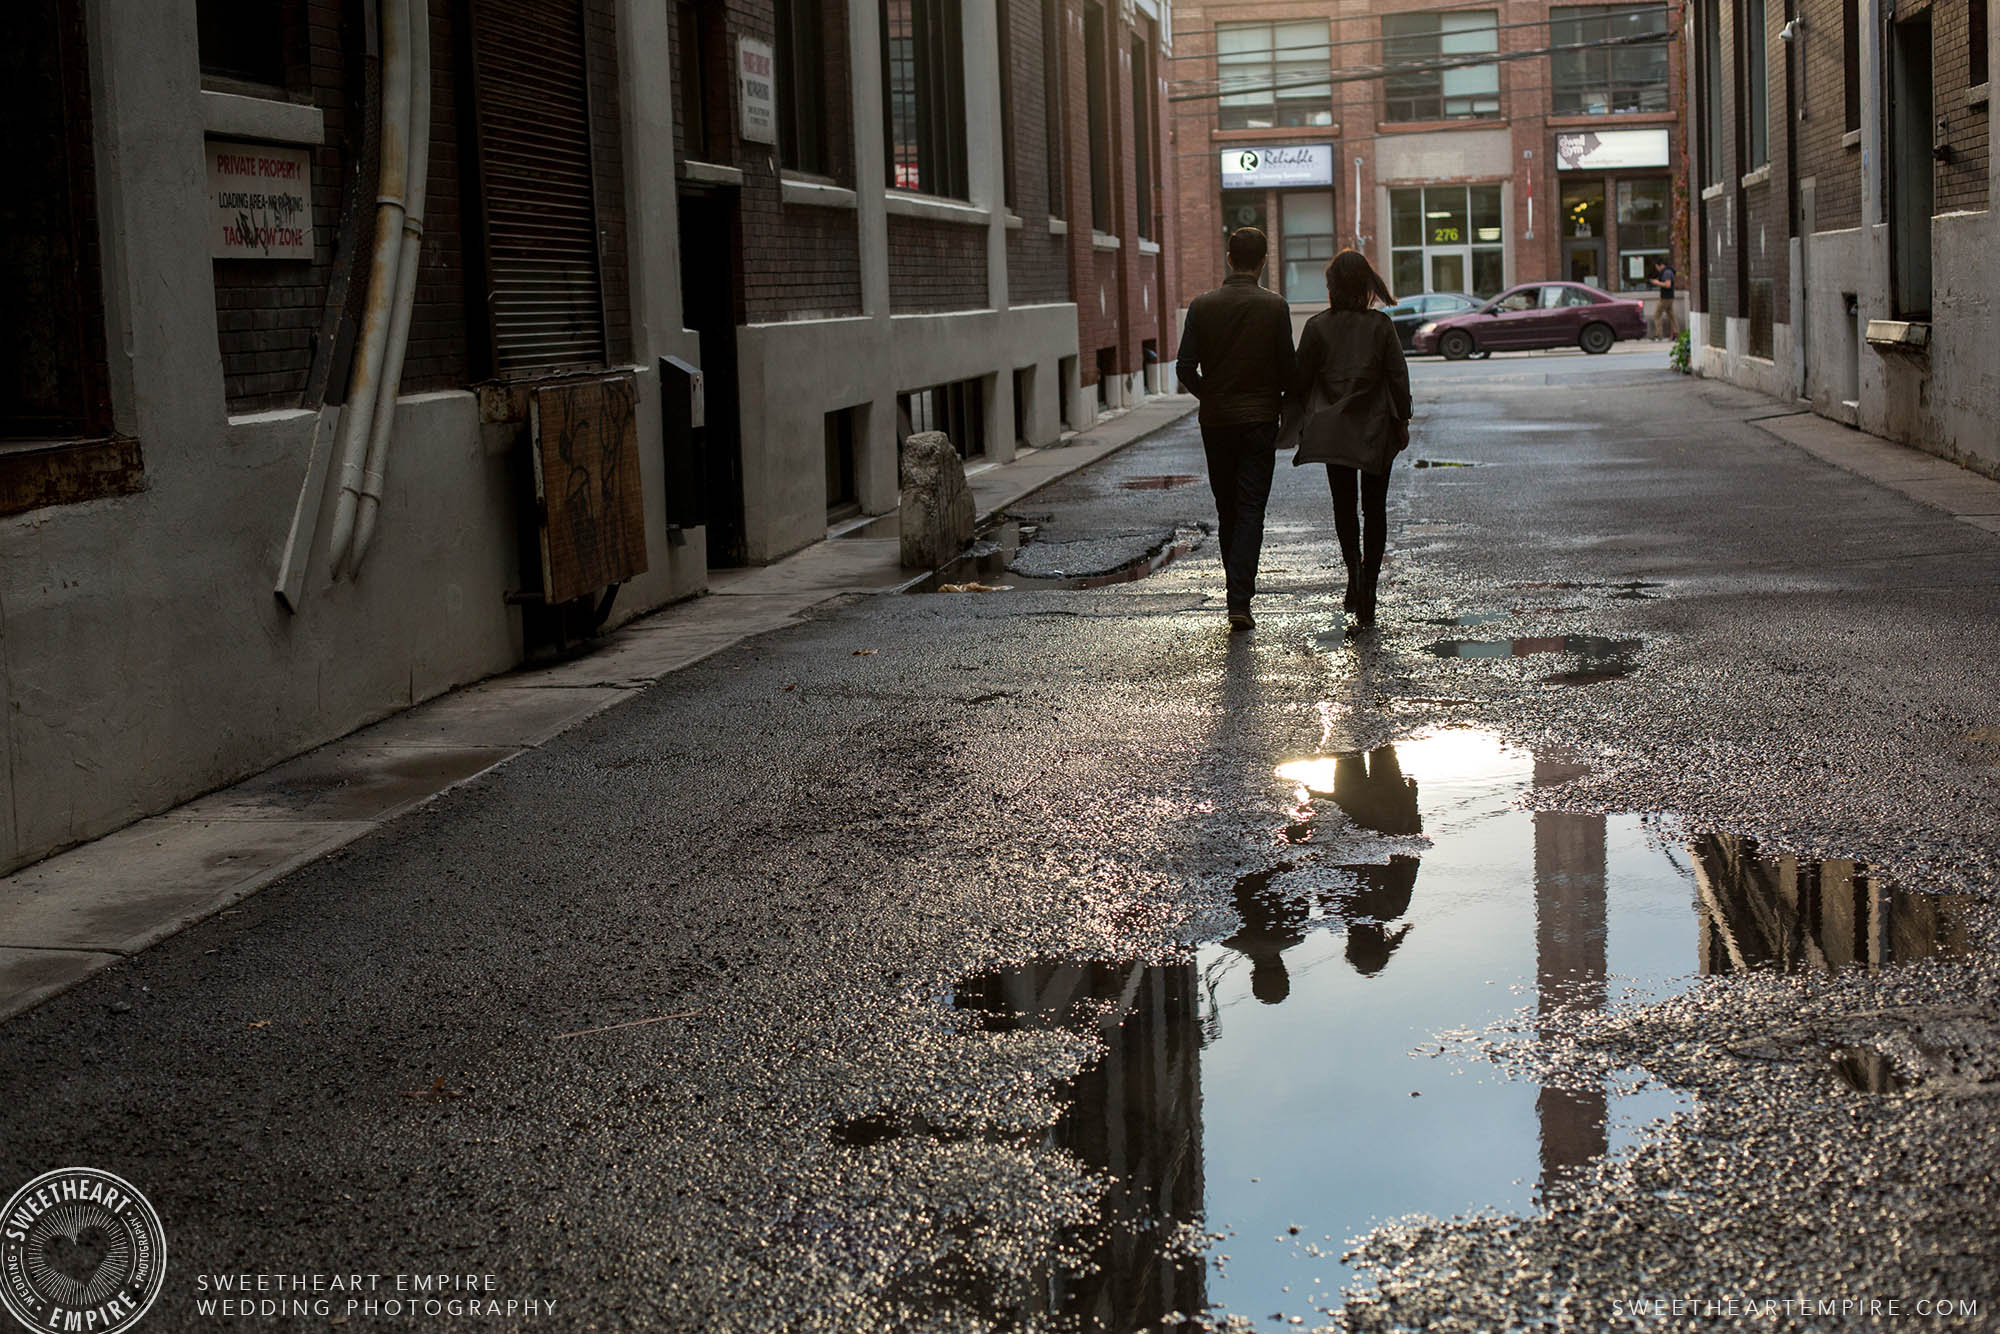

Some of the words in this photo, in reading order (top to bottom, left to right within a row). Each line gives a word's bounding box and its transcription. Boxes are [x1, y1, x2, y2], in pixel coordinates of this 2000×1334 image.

[217, 154, 256, 176] PRIVATE
[1264, 149, 1313, 165] Reliable
[219, 192, 248, 208] LOADING
[279, 227, 303, 246] ZONE
[1434, 228, 1459, 241] 276
